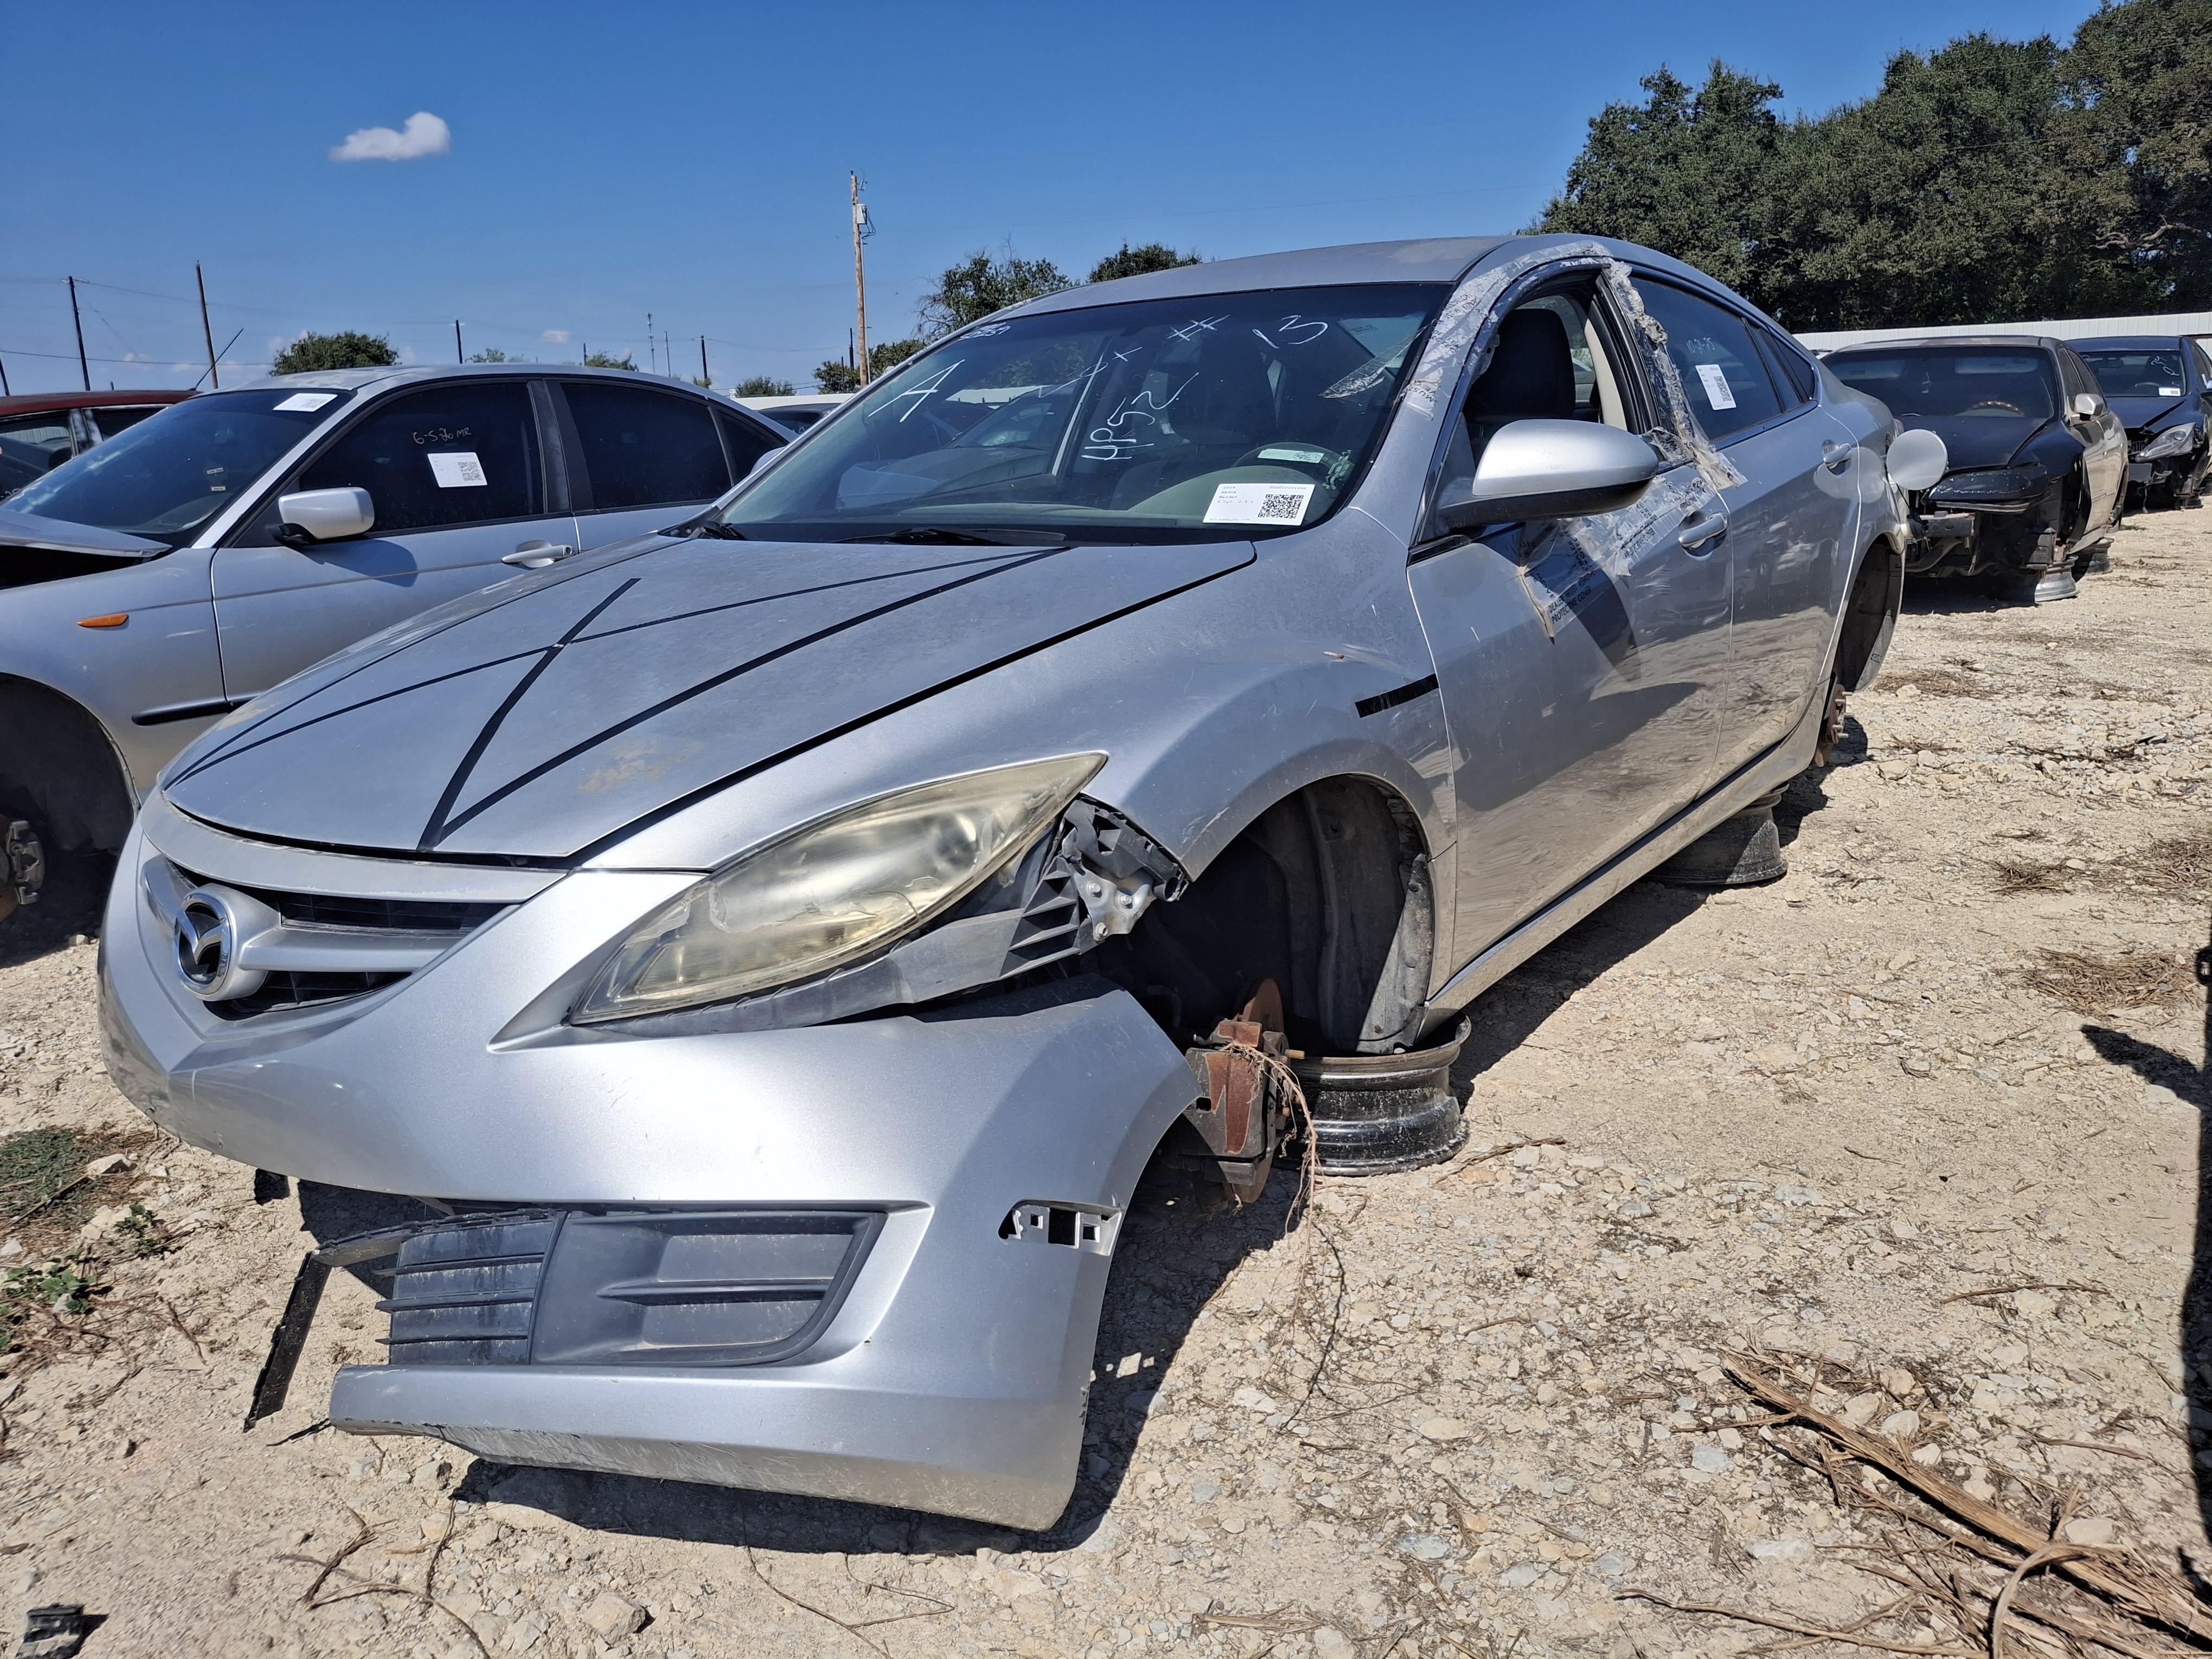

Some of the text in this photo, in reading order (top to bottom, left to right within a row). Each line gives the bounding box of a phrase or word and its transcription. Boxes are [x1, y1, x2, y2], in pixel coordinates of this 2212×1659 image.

[1252, 315, 1328, 349] 13
[867, 359, 965, 423] A
[456, 427, 472, 438] MR
[1551, 597, 1578, 625] PROTECTIVE
